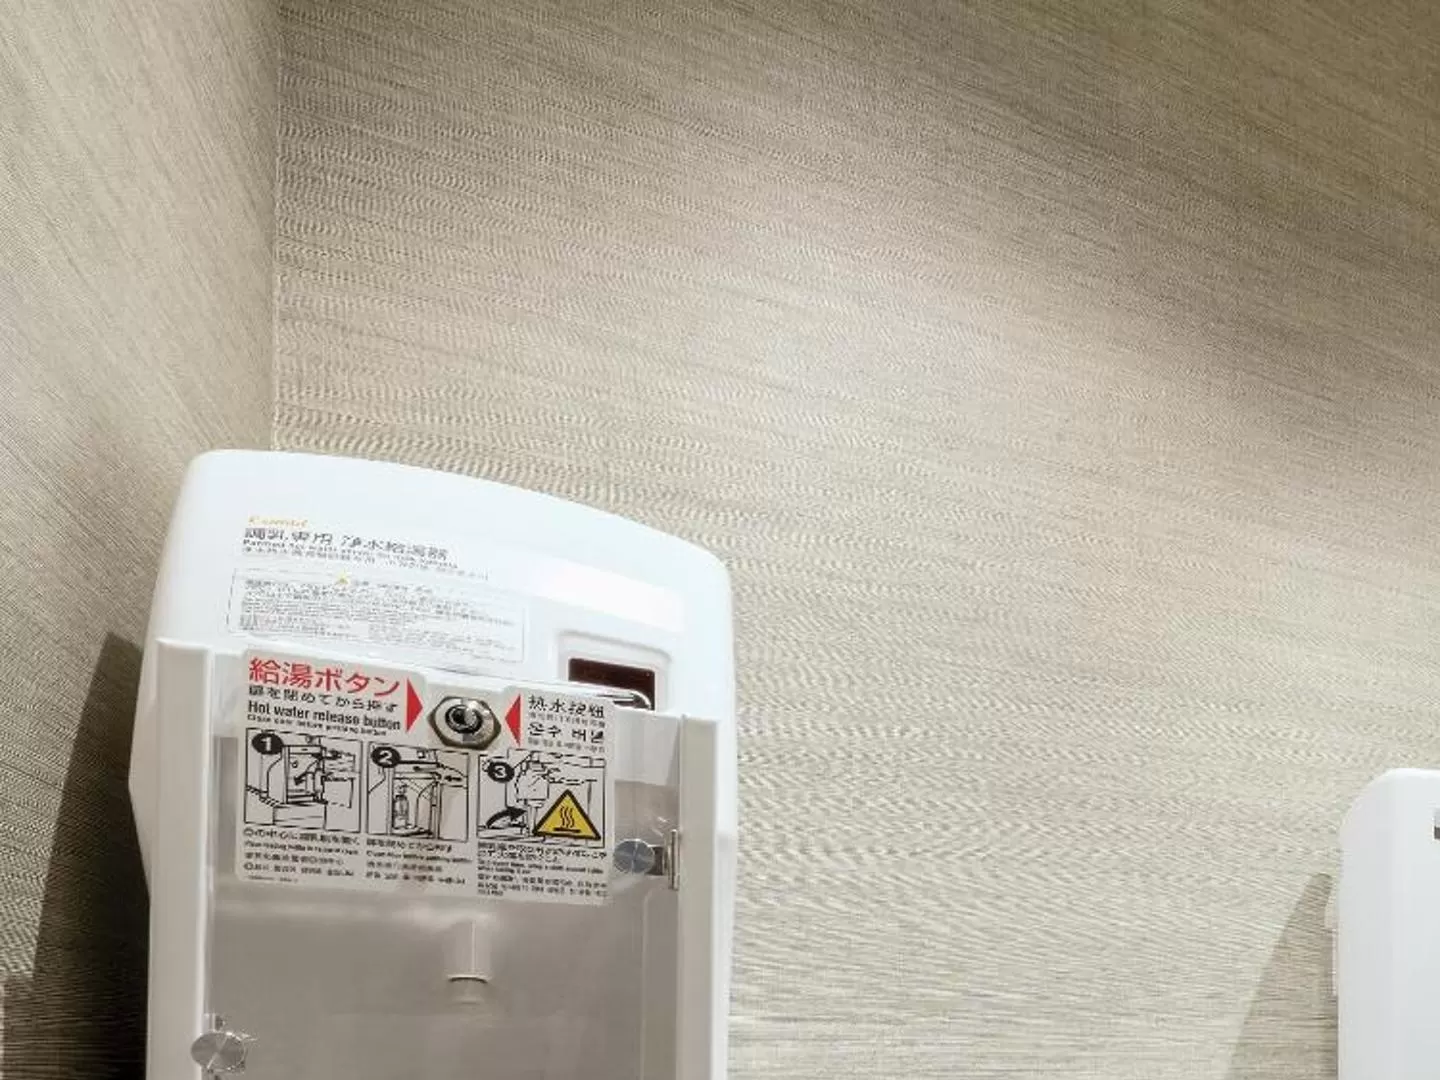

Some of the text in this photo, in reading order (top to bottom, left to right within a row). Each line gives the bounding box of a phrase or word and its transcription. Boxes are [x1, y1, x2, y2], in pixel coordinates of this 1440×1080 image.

[249, 657, 400, 697] 給湯ボタン
[248, 700, 400, 730] Hot water release button
